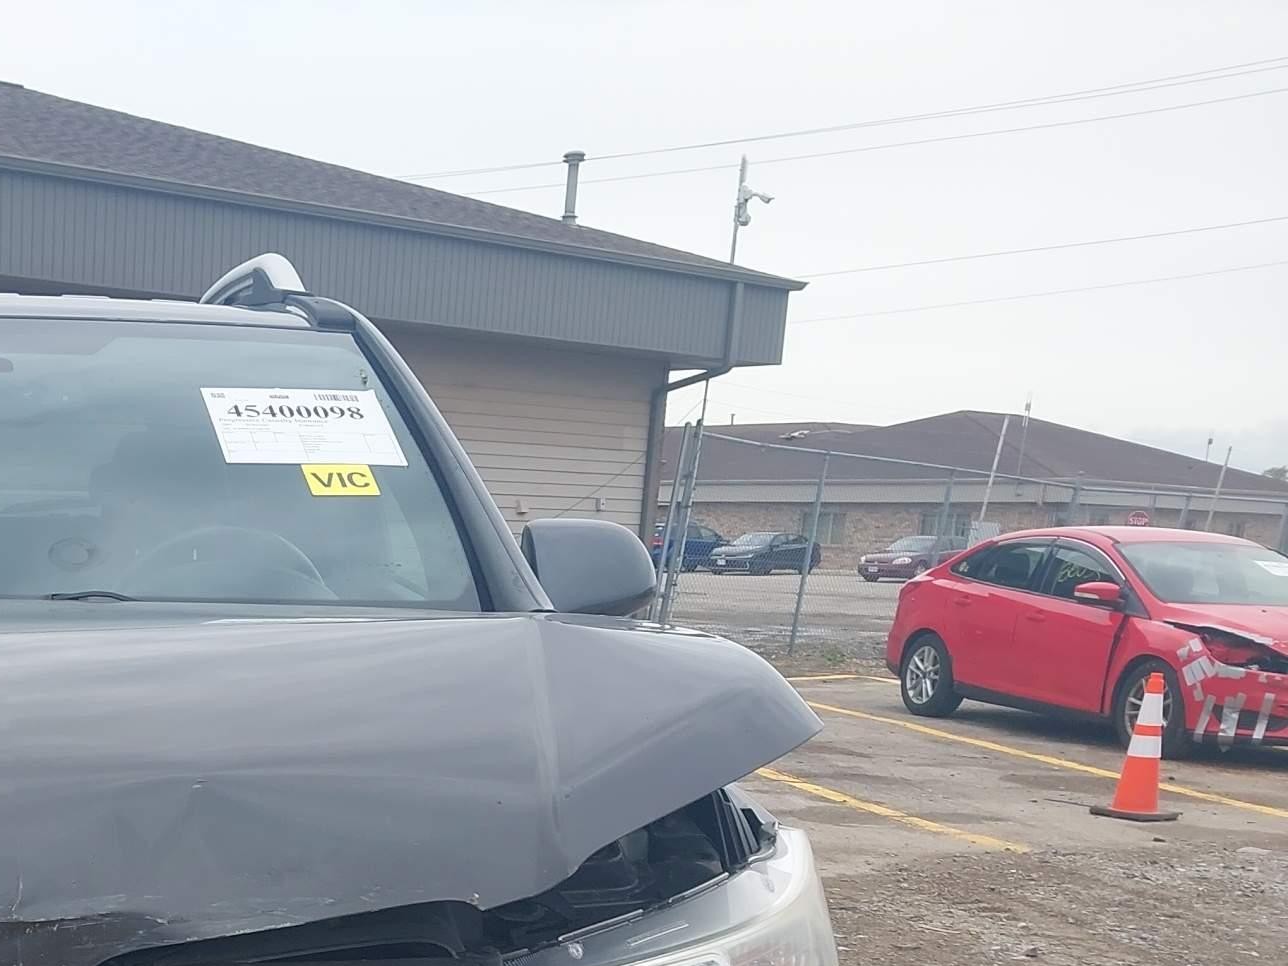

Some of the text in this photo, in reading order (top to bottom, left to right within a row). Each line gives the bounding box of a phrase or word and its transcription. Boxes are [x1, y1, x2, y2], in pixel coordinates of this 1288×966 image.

[227, 404, 365, 420] 45400098
[311, 472, 370, 488] VIC
[1129, 517, 1148, 525] STOP
